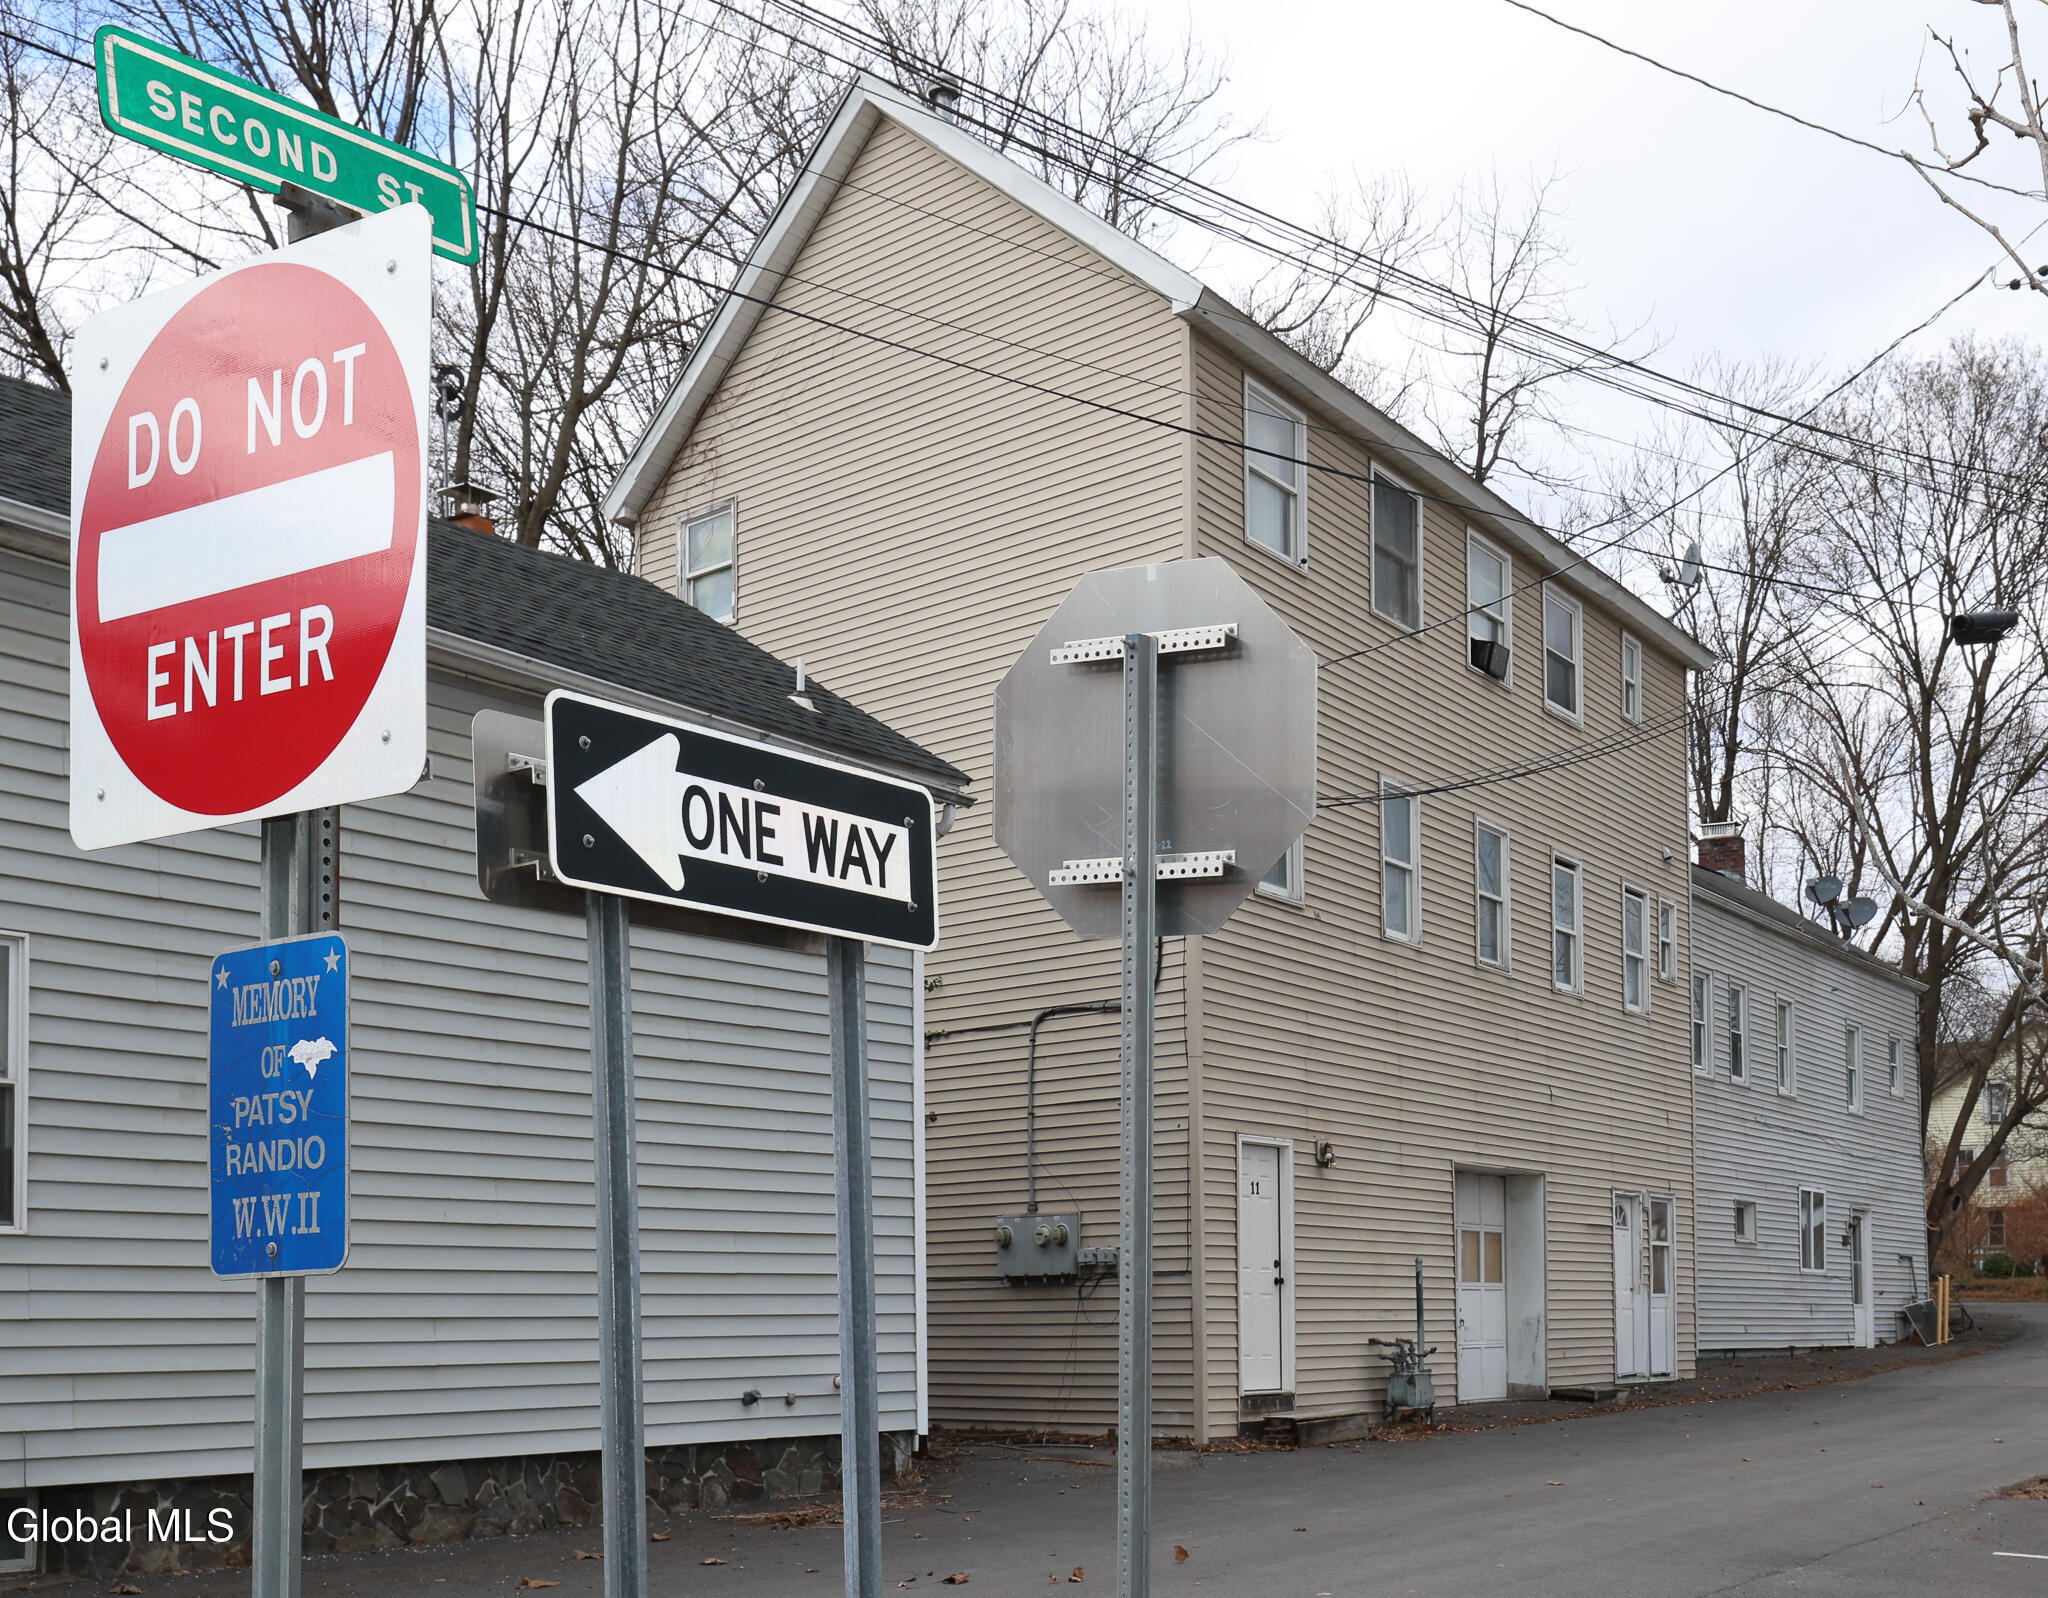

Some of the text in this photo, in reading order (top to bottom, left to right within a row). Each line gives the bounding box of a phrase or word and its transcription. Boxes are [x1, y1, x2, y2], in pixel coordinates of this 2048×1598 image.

[146, 80, 338, 183] SECOND
[127, 343, 366, 489] DO NOT
[147, 604, 335, 721] ENTER
[682, 785, 897, 889] ONE WAY
[232, 975, 320, 1027] MEMORY
[261, 1045, 286, 1078] OF
[234, 1089, 314, 1129] PATSY
[226, 1135, 326, 1176] RANDIO
[1250, 1181, 1260, 1195] 11
[232, 1191, 321, 1239] W.W.II
